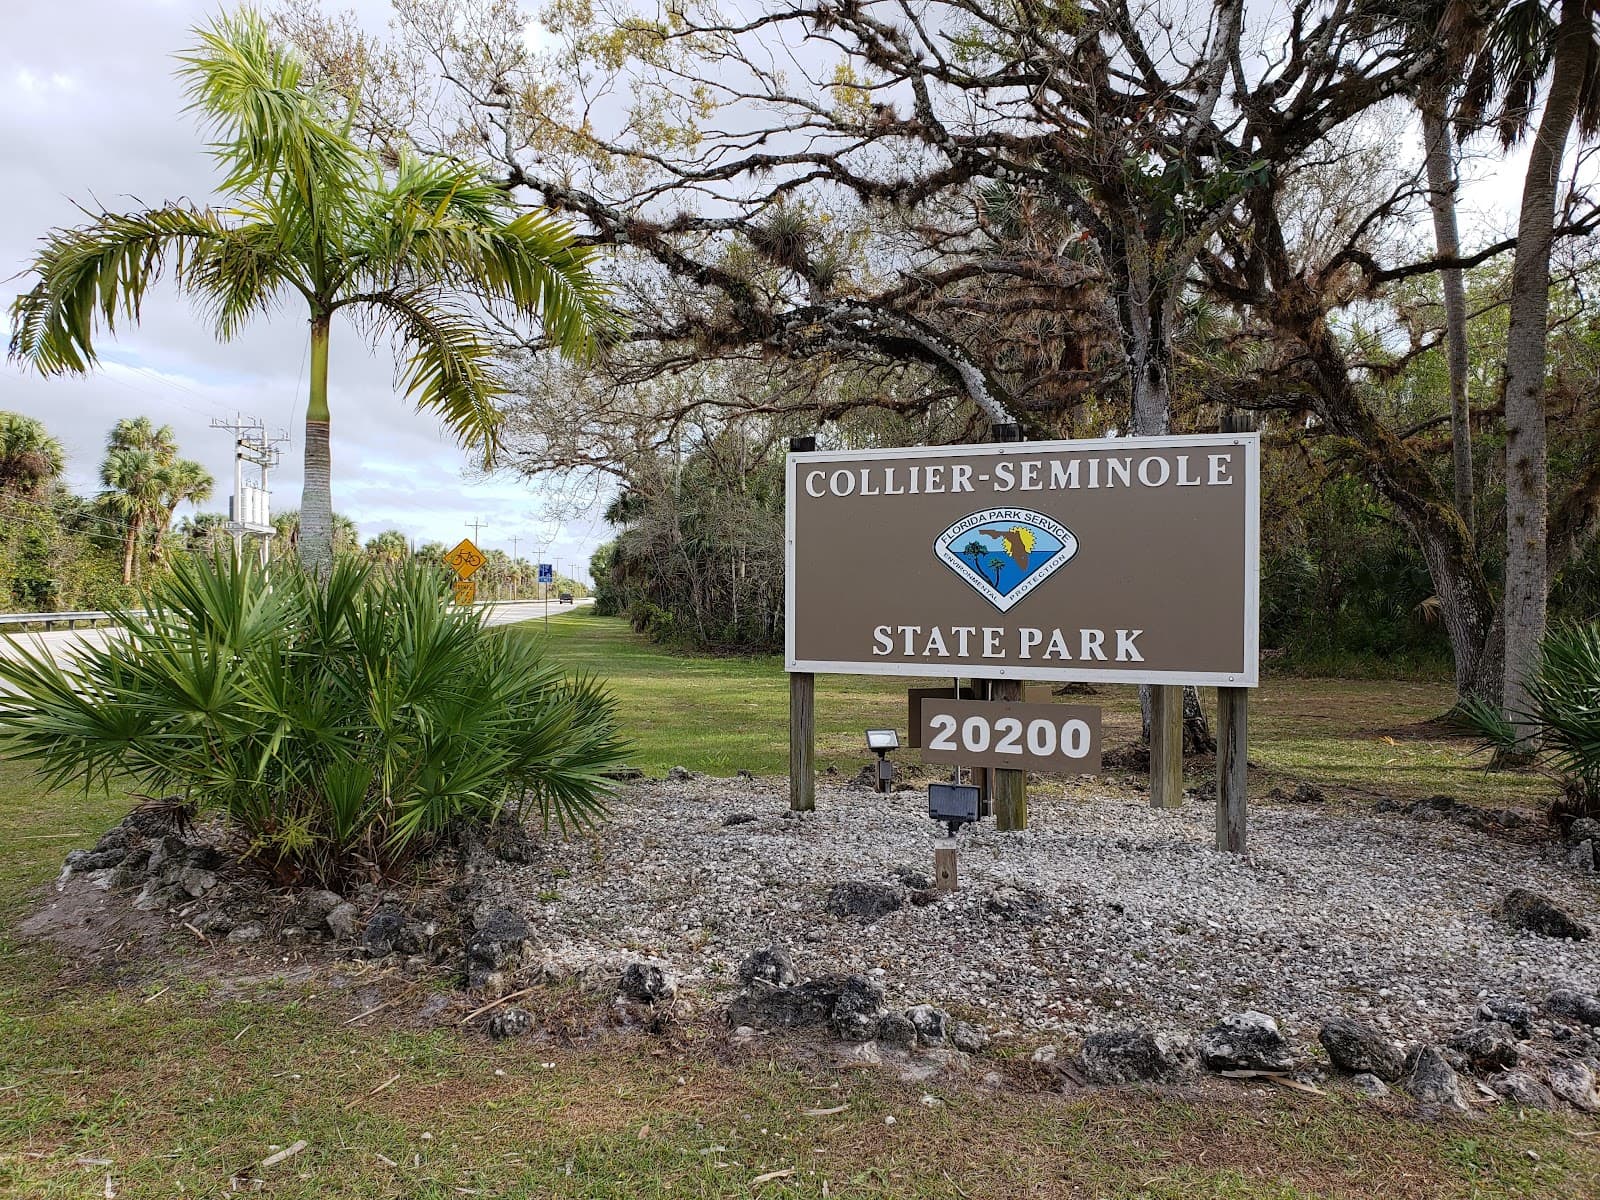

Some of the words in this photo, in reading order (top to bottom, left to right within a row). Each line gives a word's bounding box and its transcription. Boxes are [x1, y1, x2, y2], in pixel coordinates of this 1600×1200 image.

[805, 453, 1234, 498] COLLIER-SEMINOLE
[941, 514, 987, 544] FLORIDA
[989, 511, 1021, 520] PARK
[1024, 513, 1072, 543] SERVICE
[943, 552, 998, 602] ENVIRONMENTAL
[1008, 554, 1066, 601] PROTECTION
[872, 625, 1006, 659] STATE
[1018, 627, 1146, 663] PARK
[928, 714, 1091, 759] 20200
